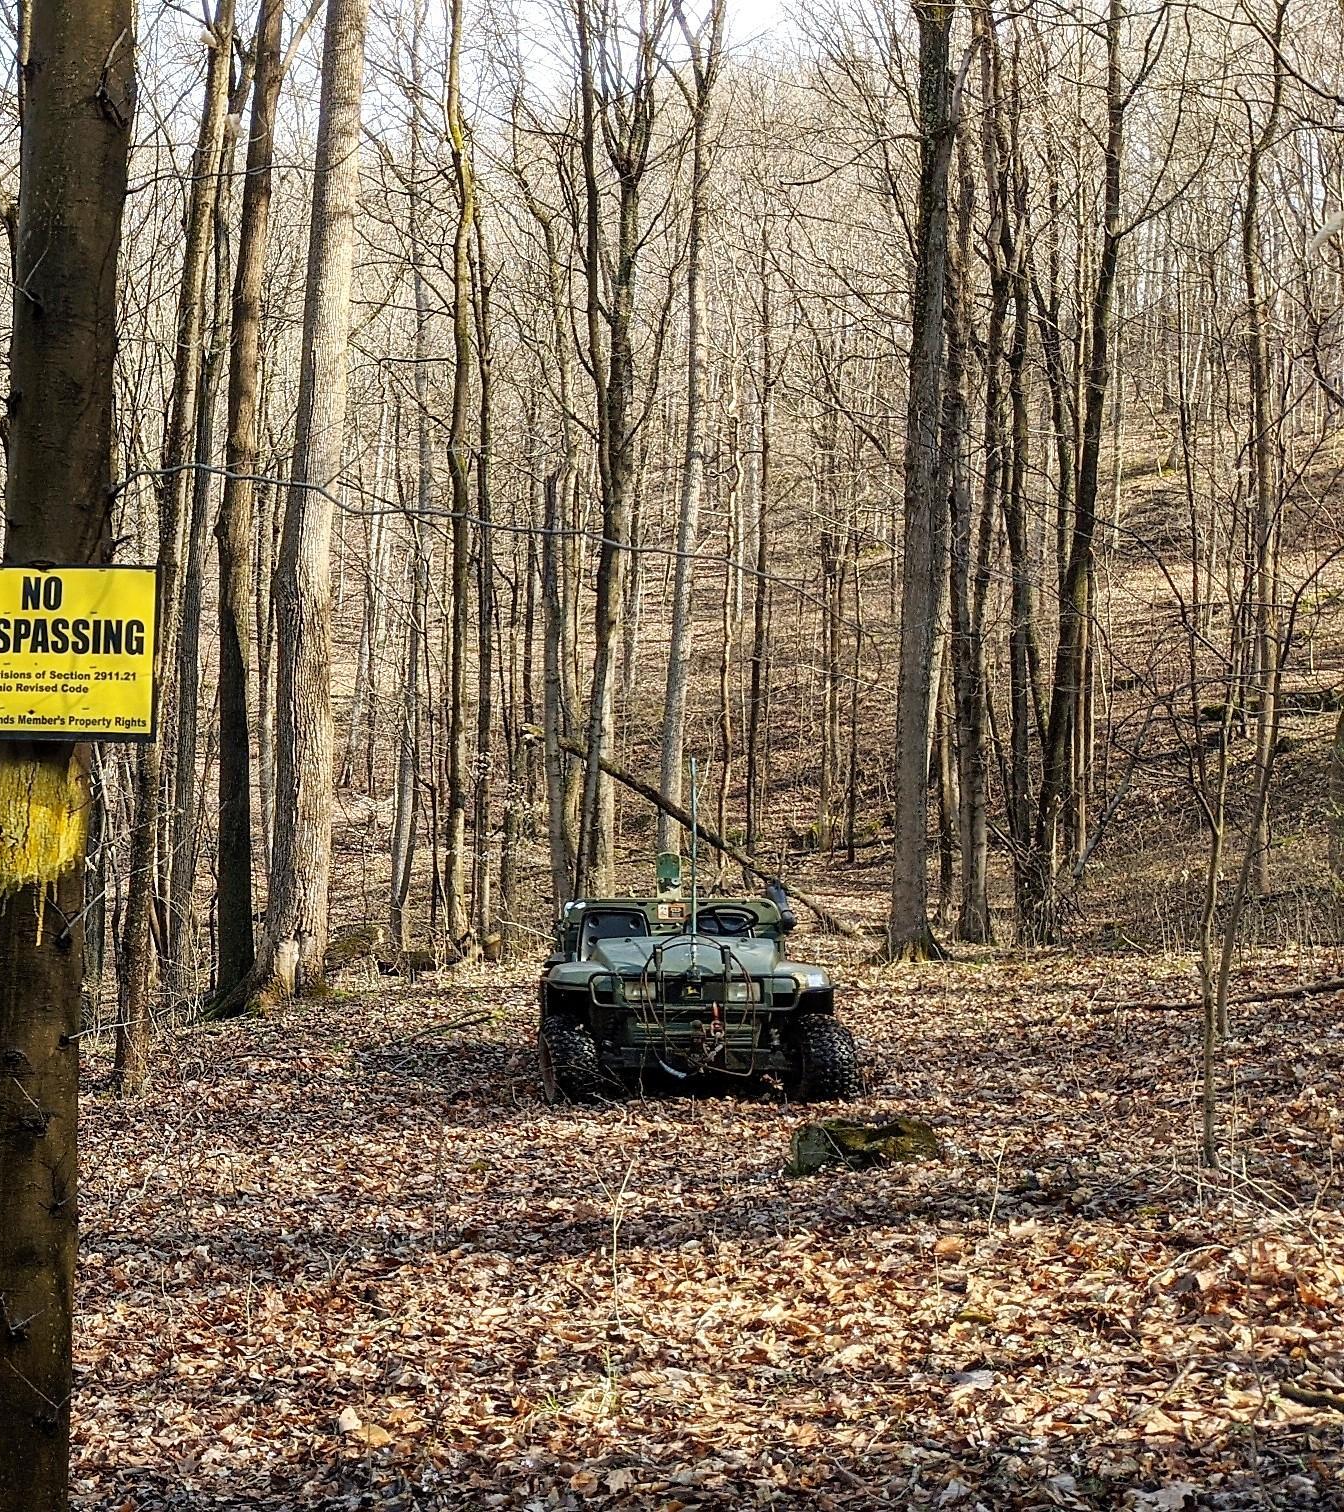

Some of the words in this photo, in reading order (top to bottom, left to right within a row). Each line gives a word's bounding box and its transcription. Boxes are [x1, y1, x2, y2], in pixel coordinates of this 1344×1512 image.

[21, 576, 63, 611] NO
[34, 670, 46, 680] of
[49, 671, 91, 681] Section
[94, 672, 137, 681] 2911.21
[15, 683, 58, 692] Revised
[61, 684, 89, 693] Code
[17, 714, 66, 725] Member's
[68, 716, 112, 728] Property
[114, 717, 147, 729] Rights
